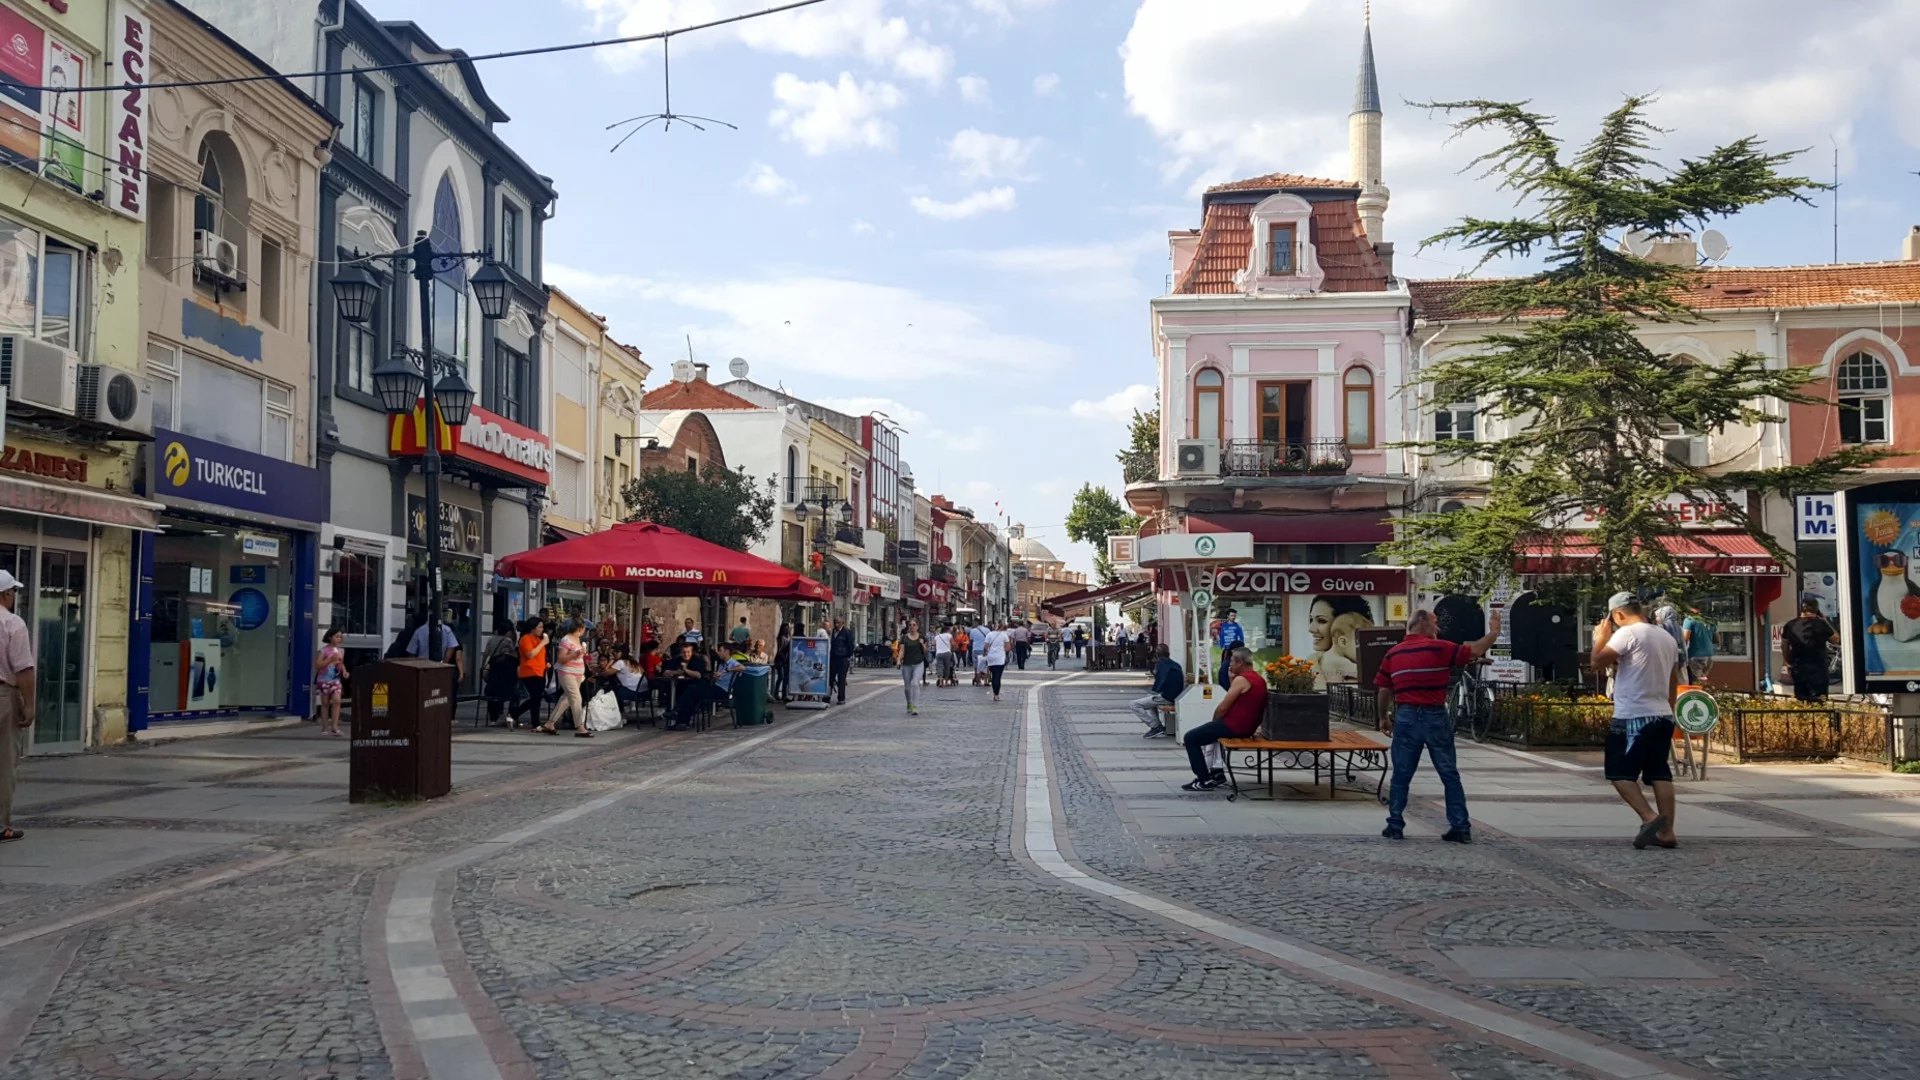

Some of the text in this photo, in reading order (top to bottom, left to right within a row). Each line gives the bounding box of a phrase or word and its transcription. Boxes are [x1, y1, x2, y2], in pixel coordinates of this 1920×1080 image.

[118, 14, 144, 214] ECZANE
[460, 412, 552, 473] McDonald's
[195, 457, 267, 495] TURKCELL
[439, 502, 459, 523] 3:00
[625, 566, 703, 580] McDonald's
[1200, 571, 1375, 592] eczane Güven
